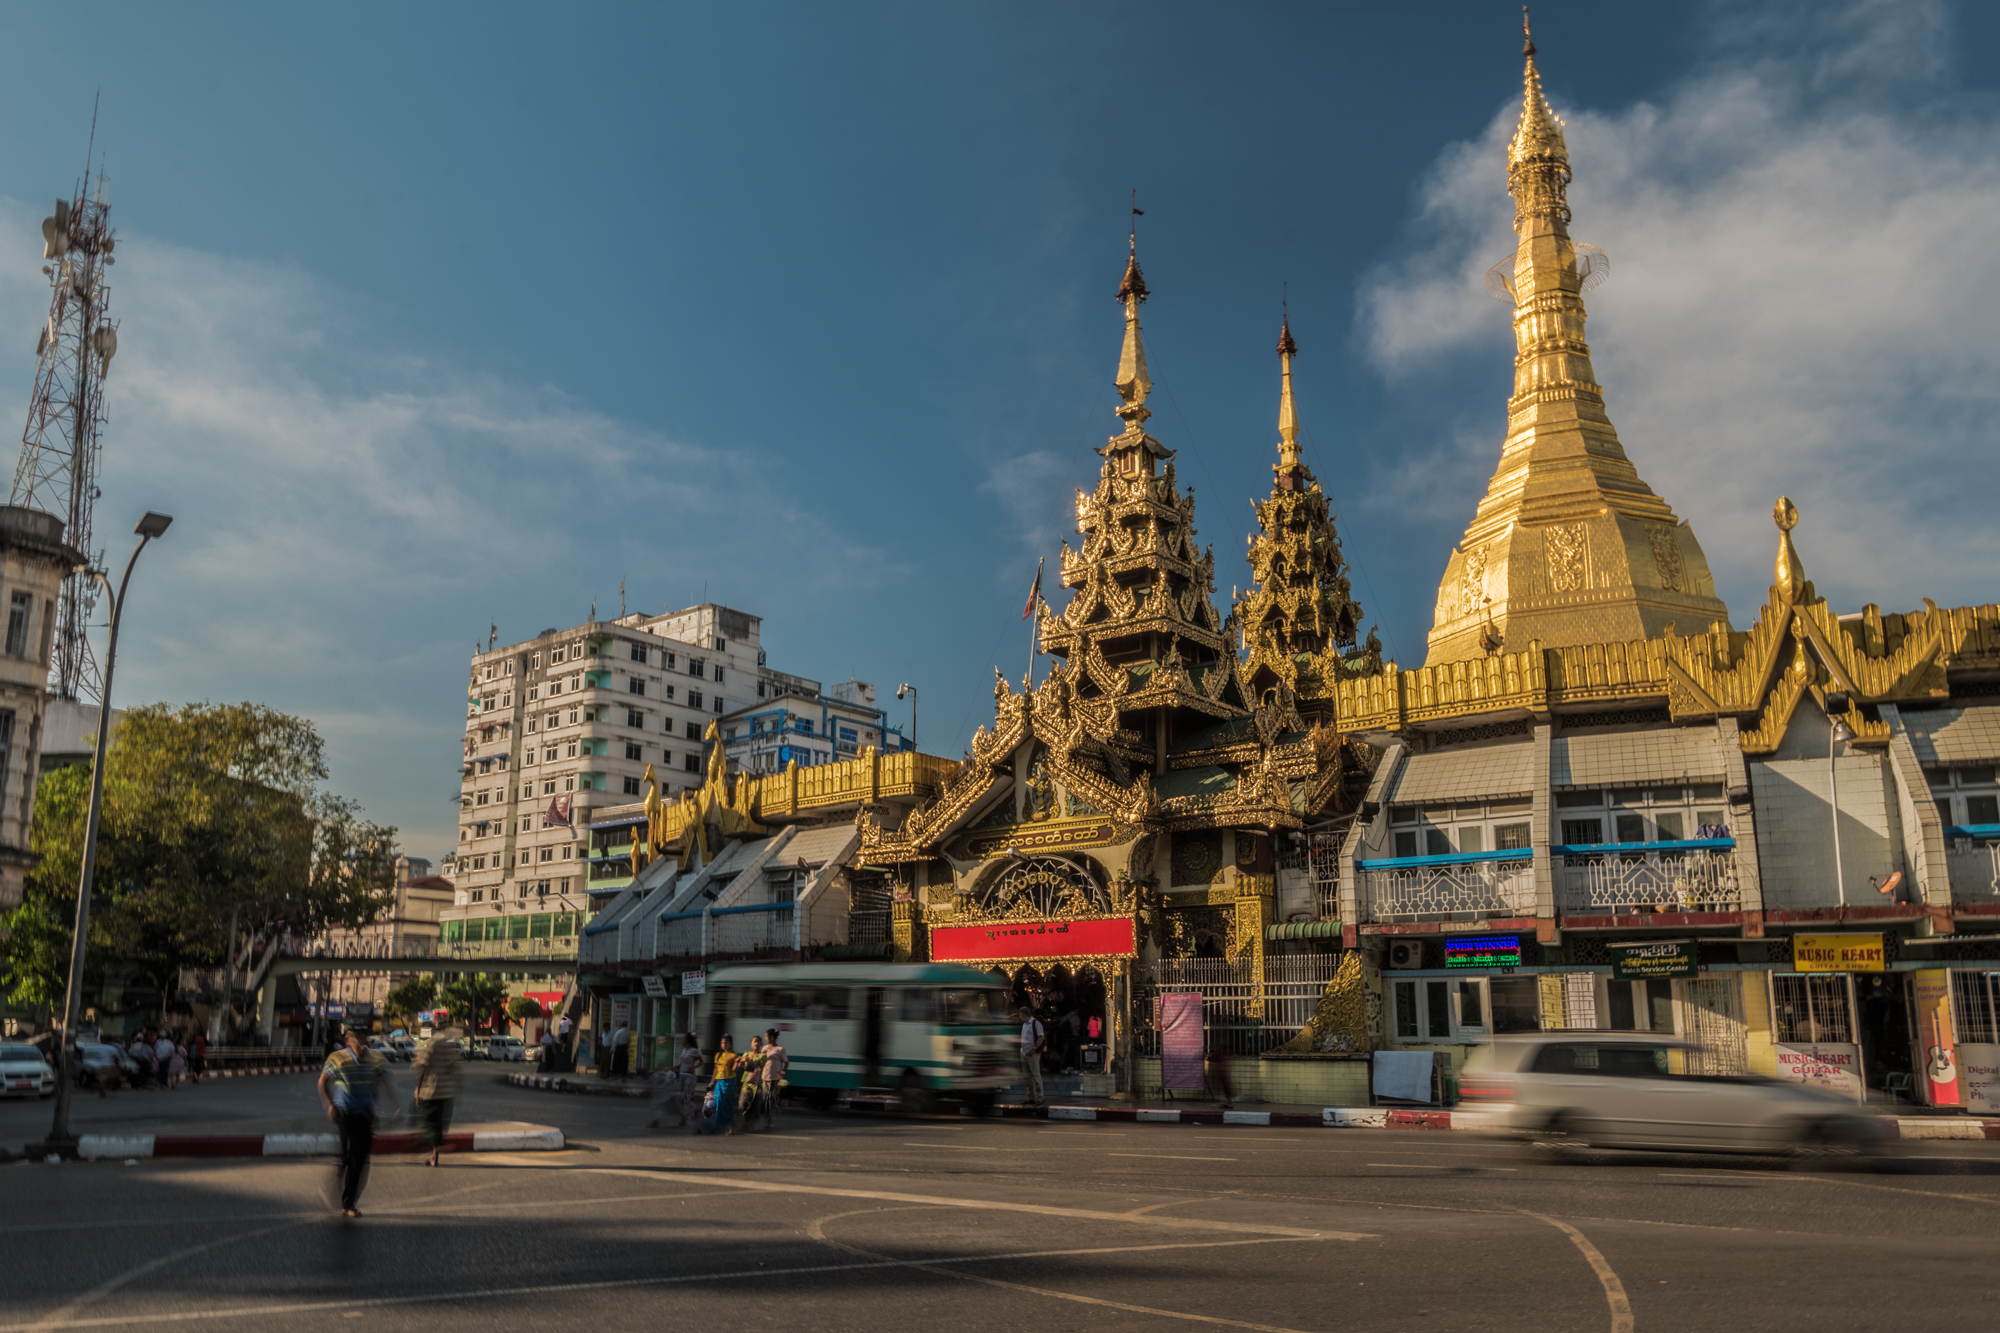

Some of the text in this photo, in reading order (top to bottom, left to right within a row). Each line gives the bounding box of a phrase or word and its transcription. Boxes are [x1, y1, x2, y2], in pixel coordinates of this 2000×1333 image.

[1448, 941, 1517, 952] EVER WINNER
[1798, 949, 1882, 961] MUSIC HEART
[1779, 1054, 1852, 1065] MUSIC HEART
[1792, 1066, 1841, 1074] GUITAR
[1968, 1066, 1998, 1074] Digital
